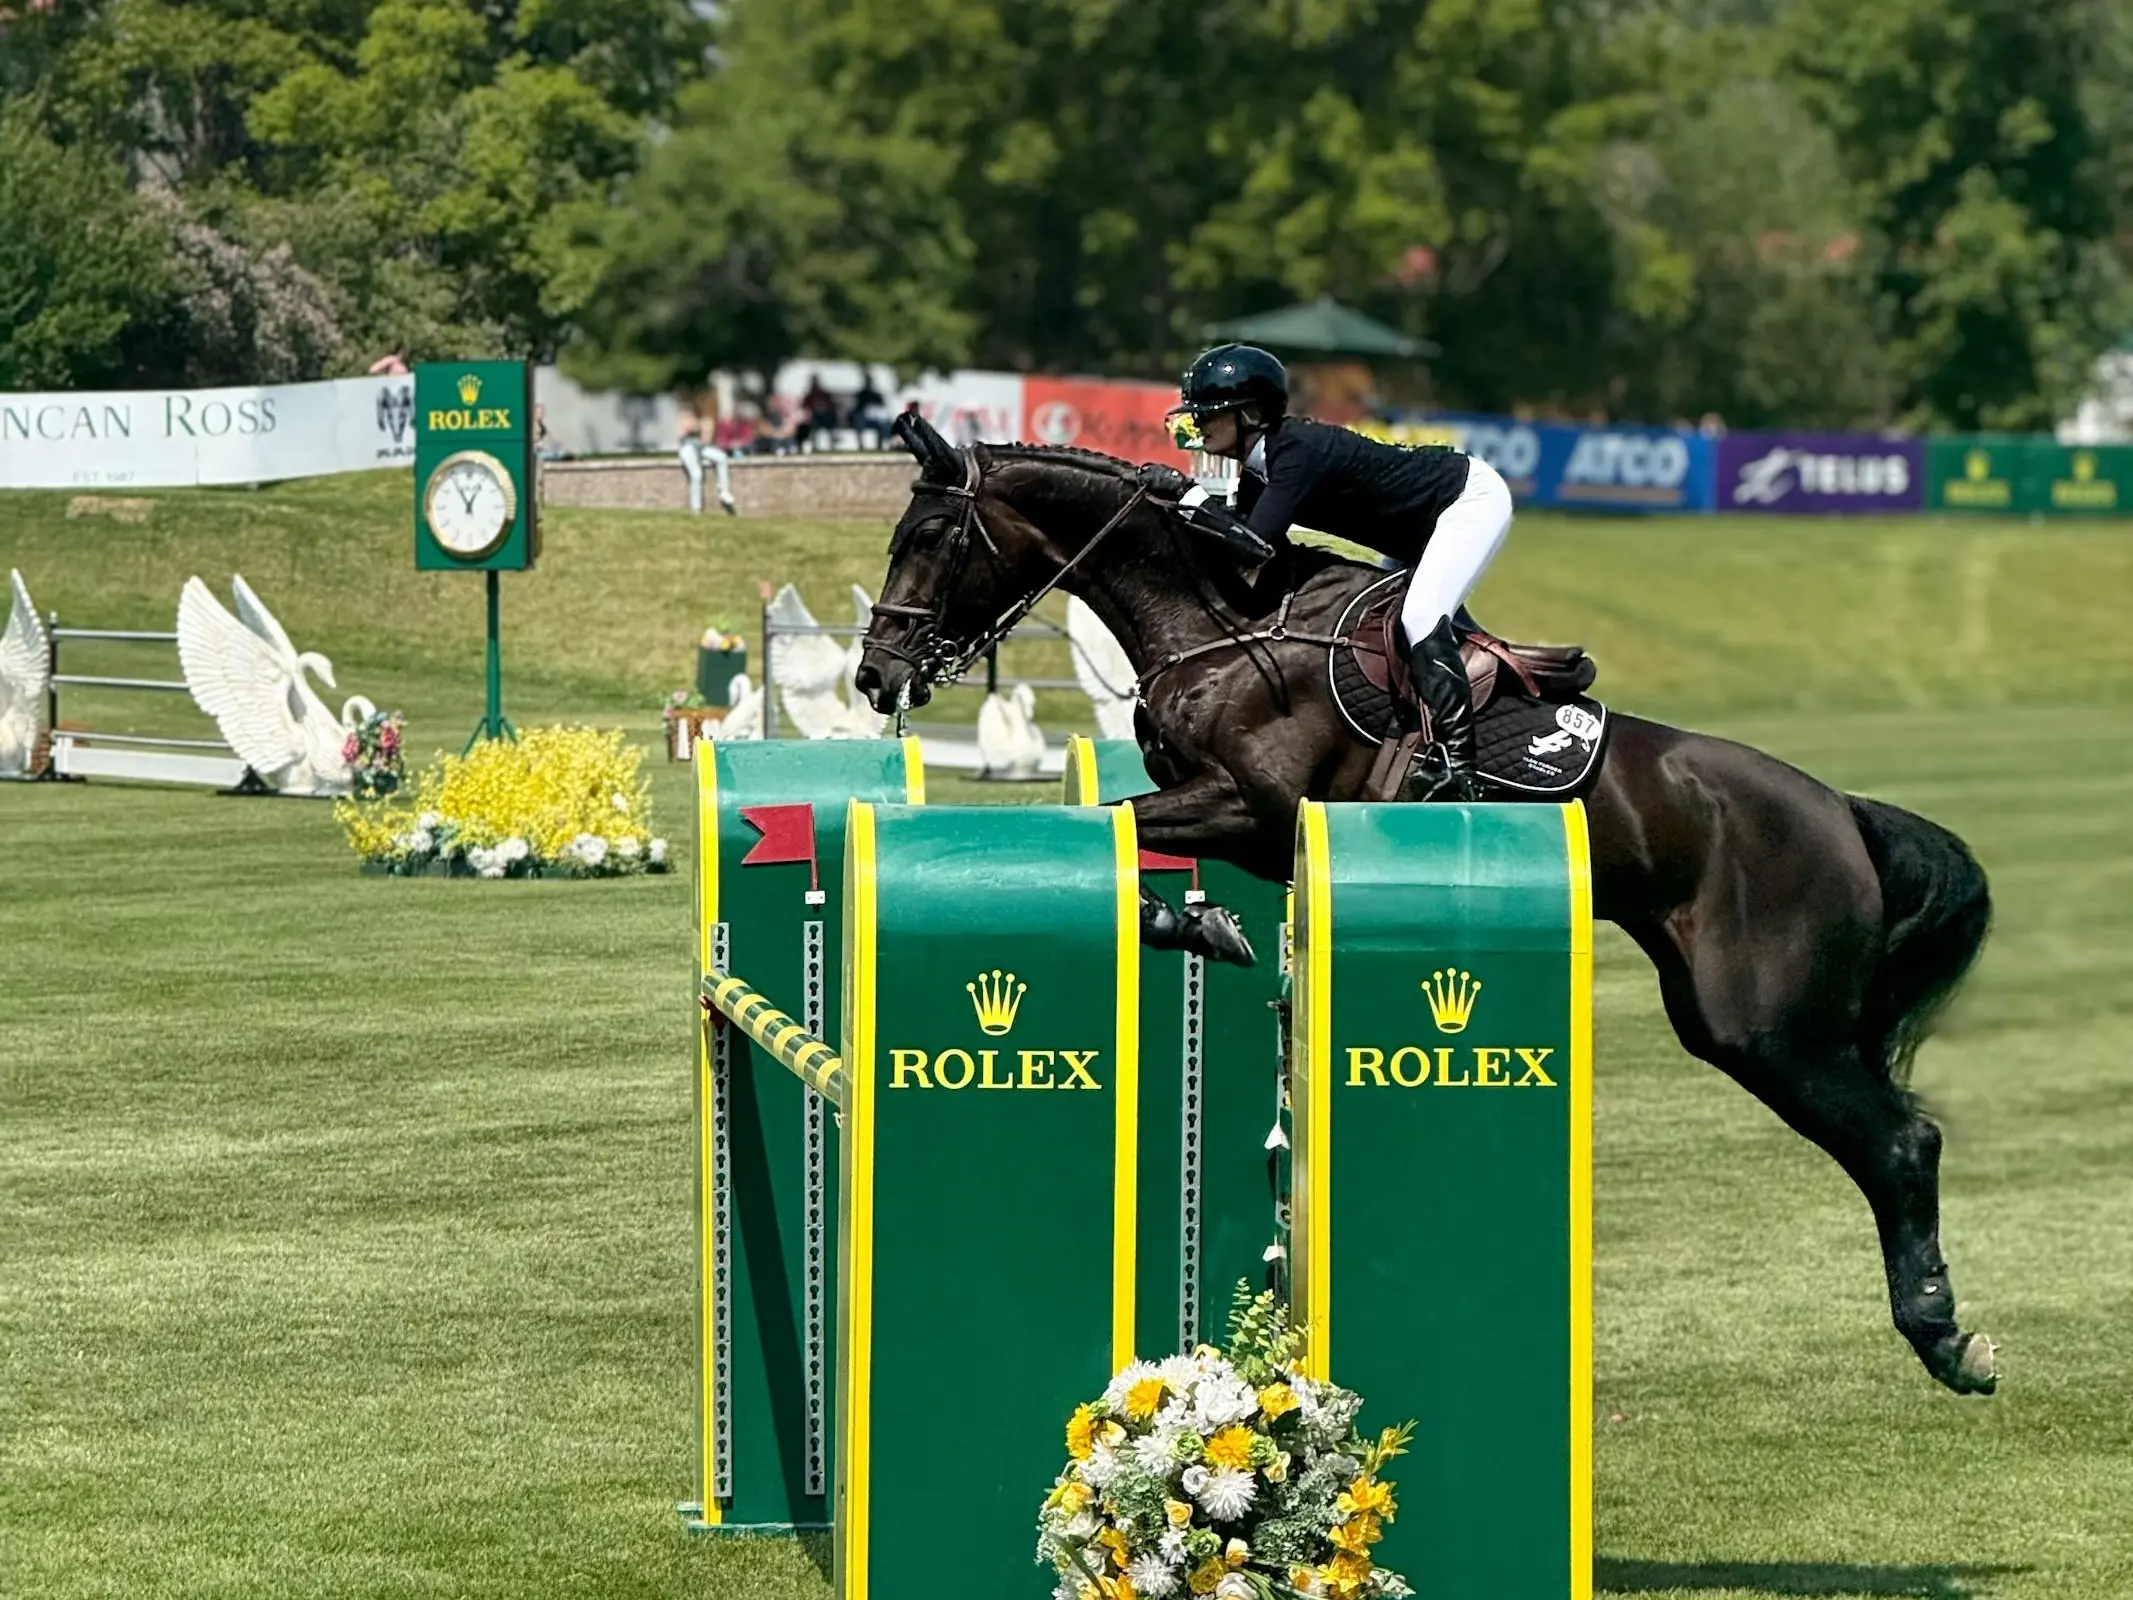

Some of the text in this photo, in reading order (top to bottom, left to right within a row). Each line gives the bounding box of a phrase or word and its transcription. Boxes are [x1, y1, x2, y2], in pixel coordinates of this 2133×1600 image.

[428, 408, 511, 431] ROLEX
[1563, 431, 1690, 487] ATCO
[1561, 707, 1596, 734] 857
[888, 1048, 1103, 1090] ROLEX
[1344, 1046, 1558, 1088] ROLEX
